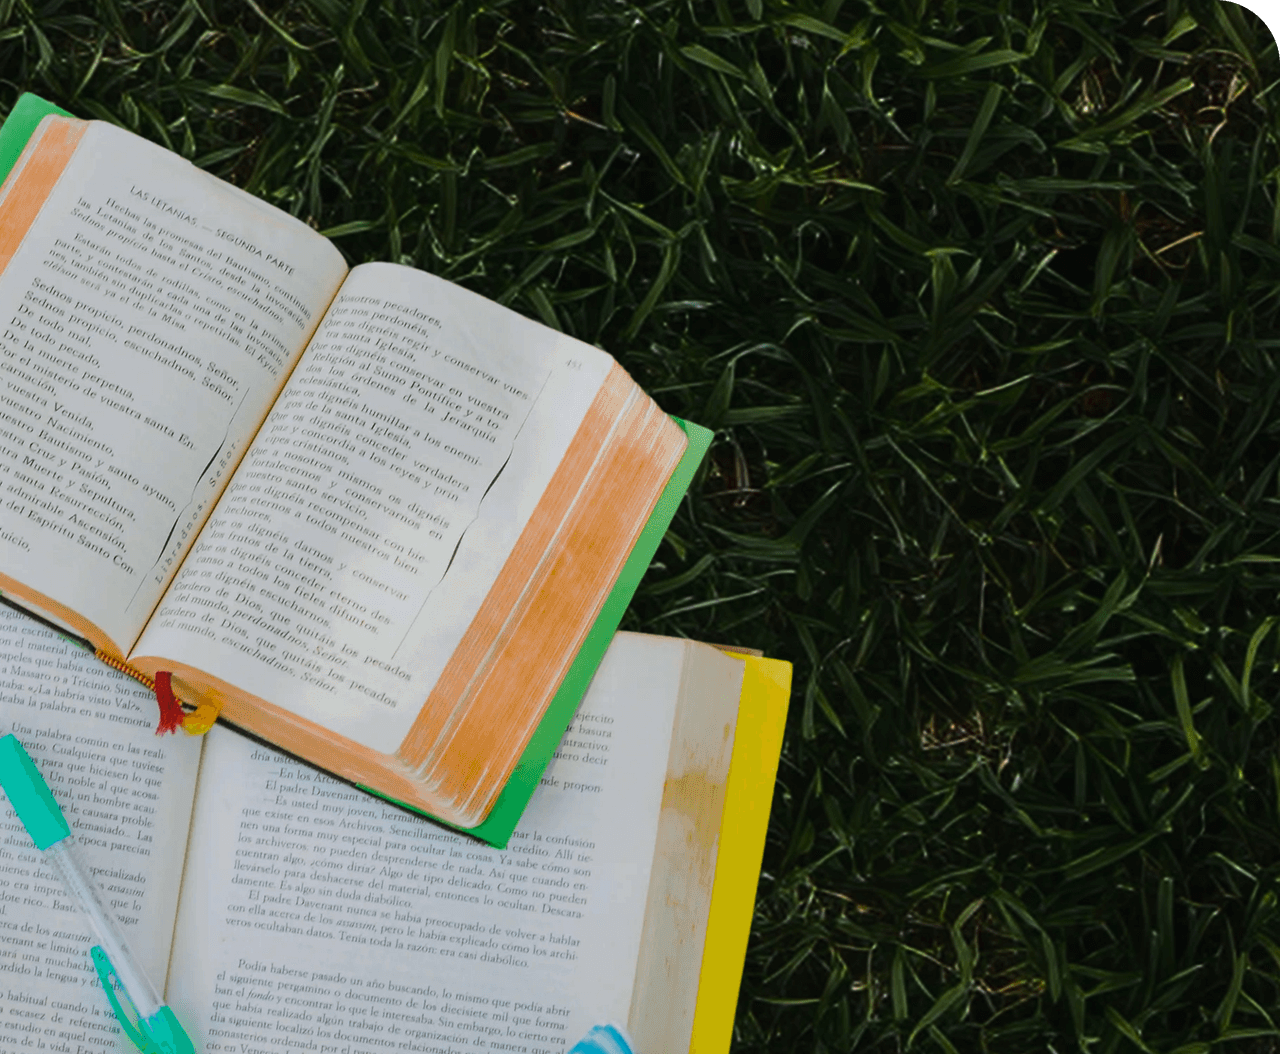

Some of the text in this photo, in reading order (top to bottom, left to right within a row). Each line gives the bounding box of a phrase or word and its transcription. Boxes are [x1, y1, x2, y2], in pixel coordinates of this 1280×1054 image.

[31, 277, 238, 387] Sednos propicio, perdonadnos, Señor,
[338, 294, 442, 329] Nosotros pecadores,
[2, 329, 134, 401] De la muerte perpetua,
[10, 316, 100, 369] De todo pecado,
[0, 362, 56, 397] carnación,
[19, 357, 31, 366] el
[32, 363, 80, 390] misterio
[82, 387, 97, 398] de
[100, 395, 142, 420] vuestra
[143, 416, 175, 437] santa
[0, 395, 42, 420] vuestro
[46, 416, 114, 457] Nacimiento,
[283, 387, 301, 398] Que
[315, 391, 359, 410] dignéis
[360, 403, 411, 432] humillar
[412, 429, 421, 437] a
[423, 432, 441, 447] los
[304, 400, 319, 411] de
[320, 404, 332, 415] la
[334, 410, 366, 427] santa
[369, 421, 411, 449] Iglesia,
[28, 441, 56, 461] Cruz
[58, 458, 67, 467] y
[70, 461, 111, 490] Pasión,
[38, 429, 93, 462] Bautismo
[94, 459, 104, 468] y
[107, 465, 139, 485] santo
[142, 484, 176, 512] ayuno,
[13, 470, 45, 491] santa
[49, 485, 124, 533] Resurrección,
[248, 889, 260, 901] El
[262, 892, 292, 905] padre
[294, 895, 343, 912] Davenant
[346, 906, 377, 917] nunca
[380, 911, 391, 919] se
[394, 909, 422, 924] había
[424, 917, 486, 933] preocupado
[488, 923, 502, 935] de
[505, 927, 537, 940] volver
[548, 932, 581, 947] hablar
[237, 958, 571, 1017] Podía haberse pasado un año buscando, lo mismo que podía abrir
